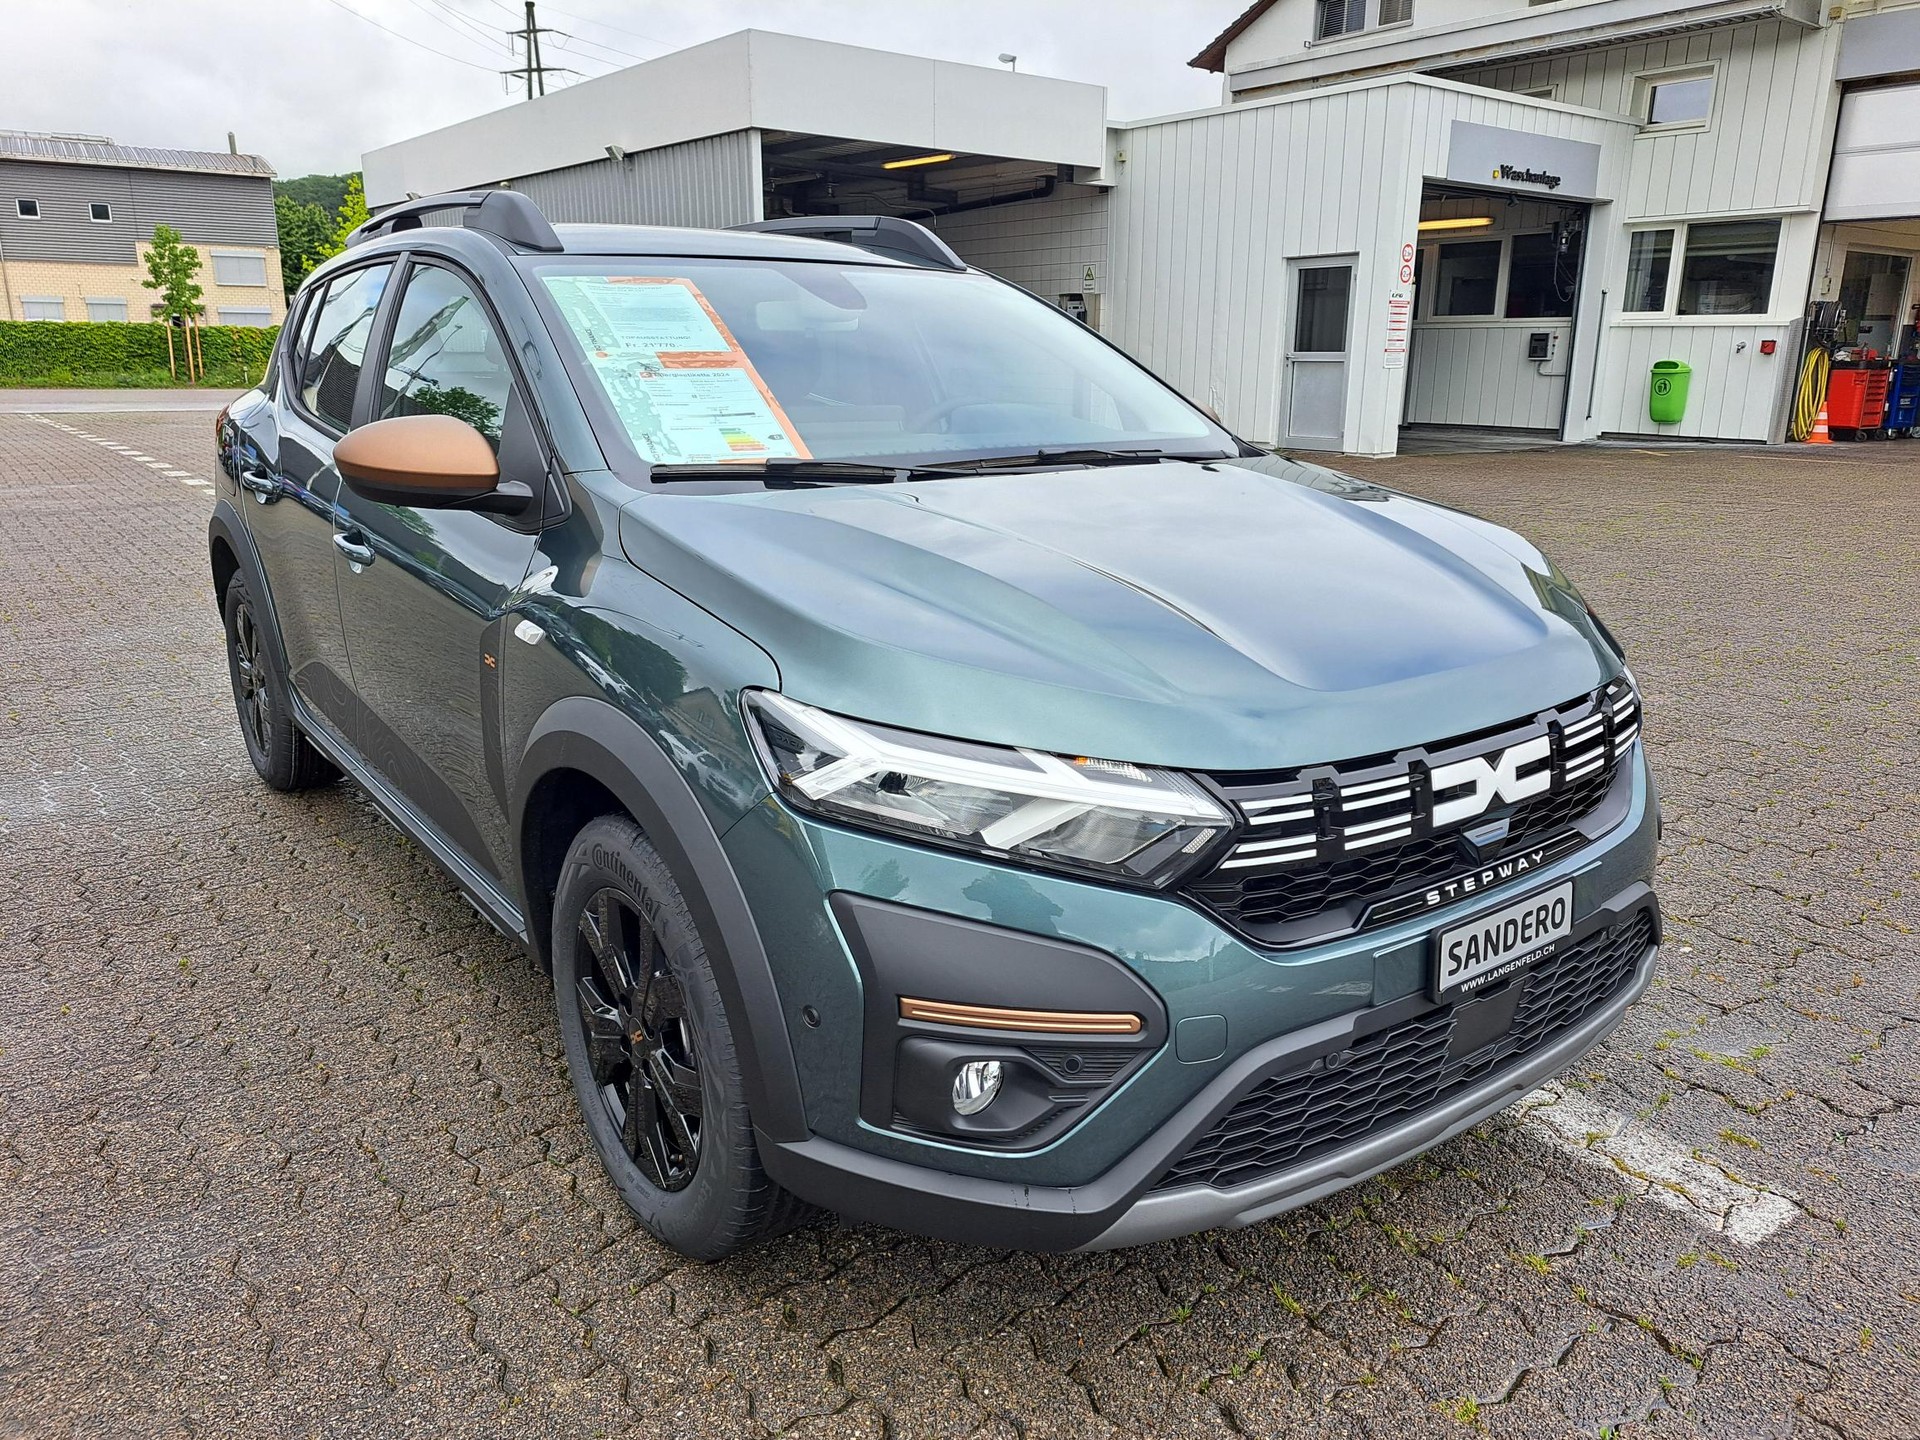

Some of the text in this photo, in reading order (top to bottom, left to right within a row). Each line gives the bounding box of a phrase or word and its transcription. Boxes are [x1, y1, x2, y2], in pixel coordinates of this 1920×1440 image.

[1500, 164, 1562, 190] Waschanlage
[591, 842, 662, 922] Continental
[1426, 850, 1544, 906] STEPWAY
[1447, 896, 1567, 978] SANDERO
[1460, 943, 1556, 993] WWW.LANGENFELD.CH
